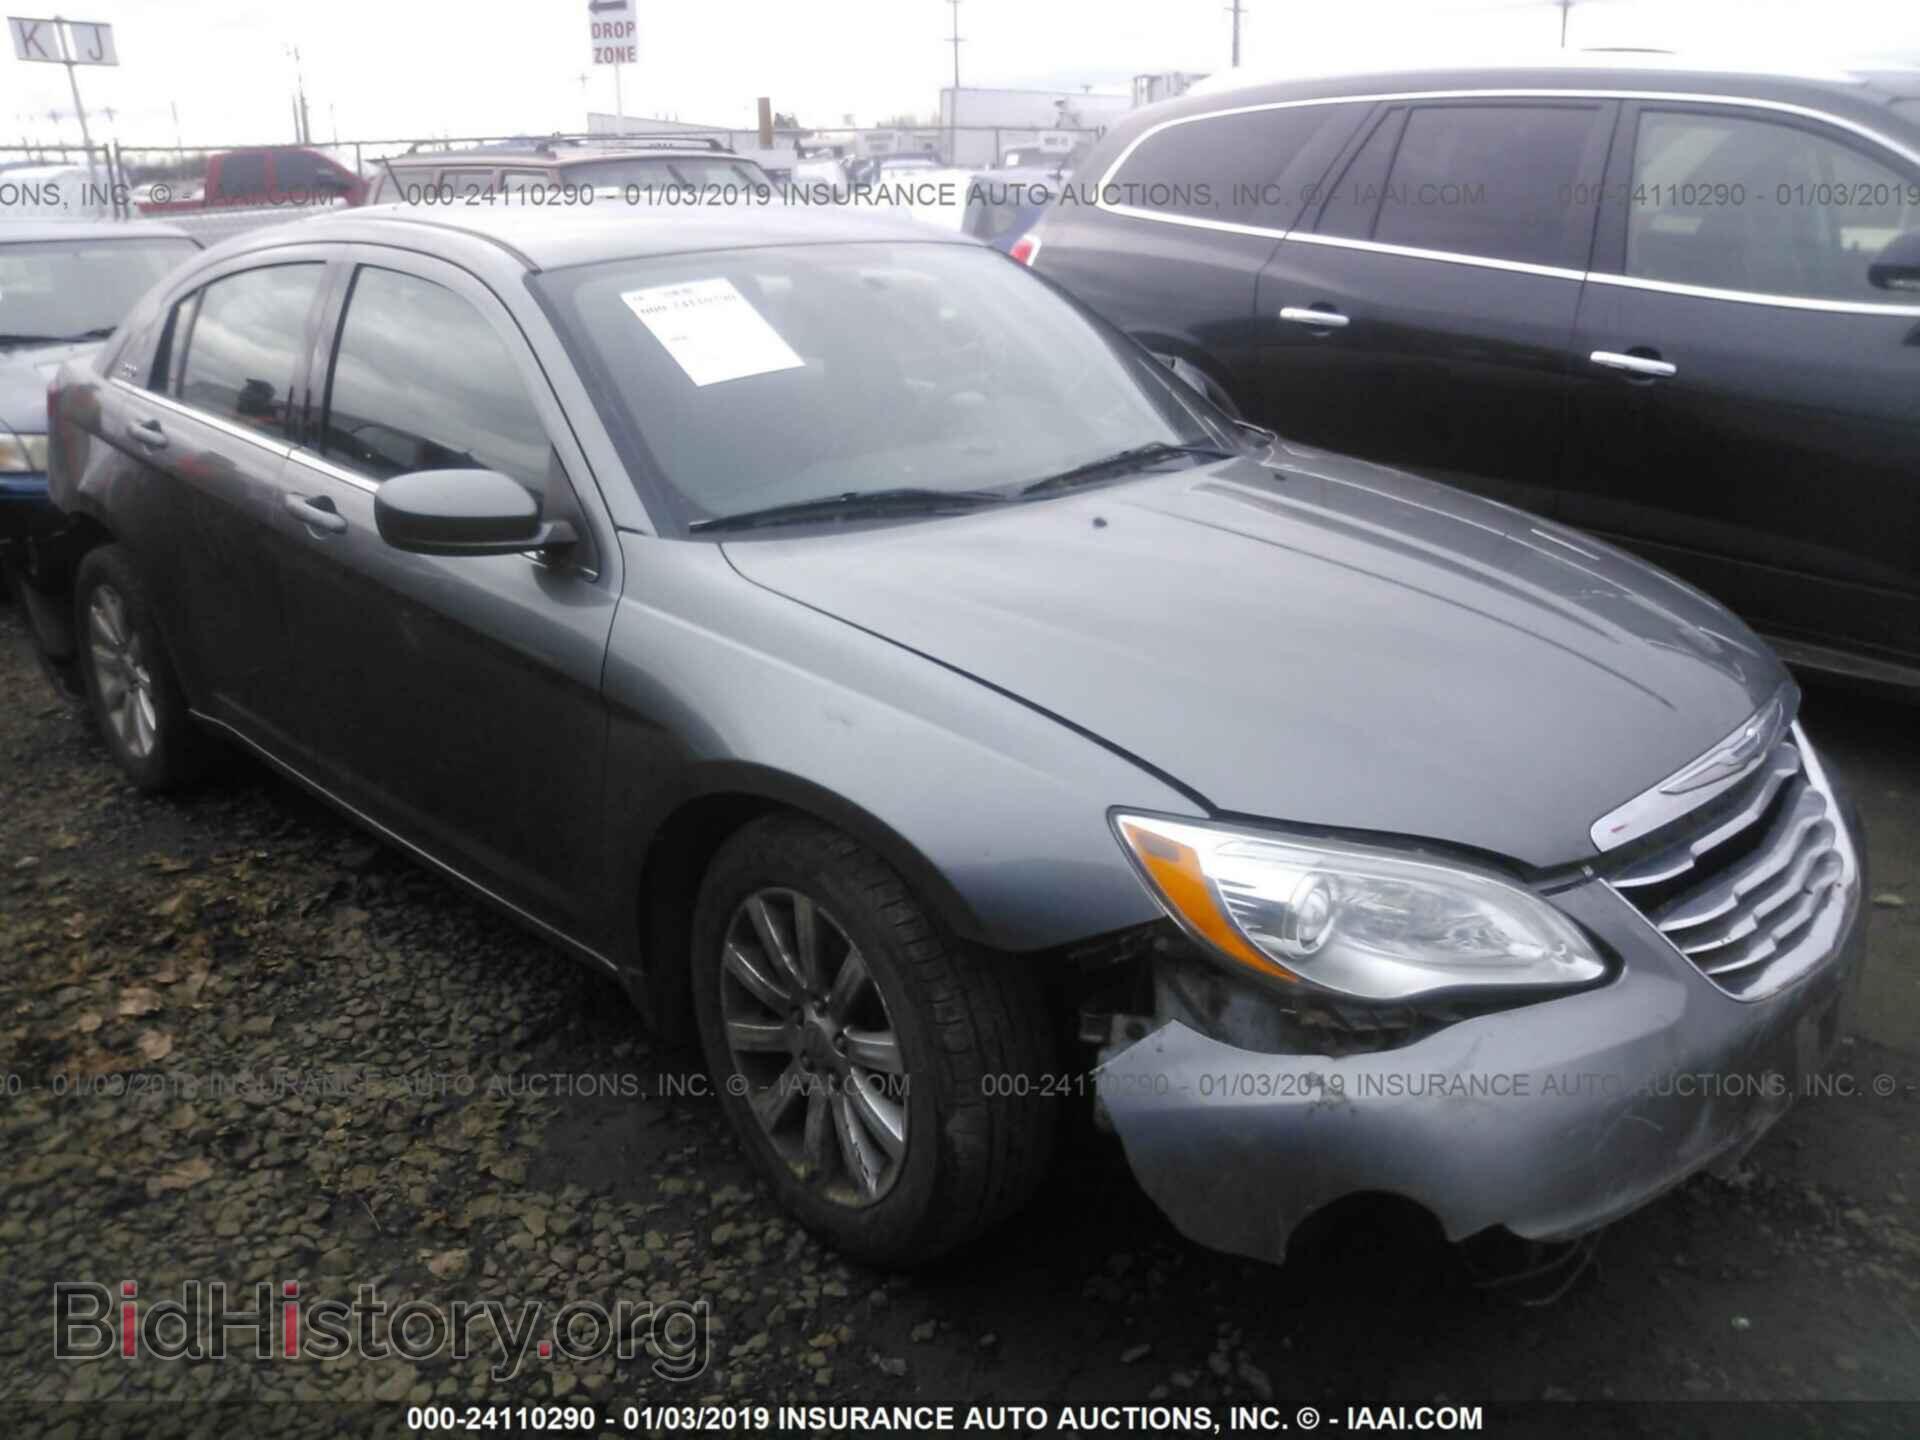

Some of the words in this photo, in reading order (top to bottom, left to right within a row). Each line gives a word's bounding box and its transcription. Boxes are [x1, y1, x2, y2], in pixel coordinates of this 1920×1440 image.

[18, 21, 48, 57] K
[87, 23, 104, 61] J
[592, 21, 636, 39] DROP
[594, 46, 637, 64] ZONE
